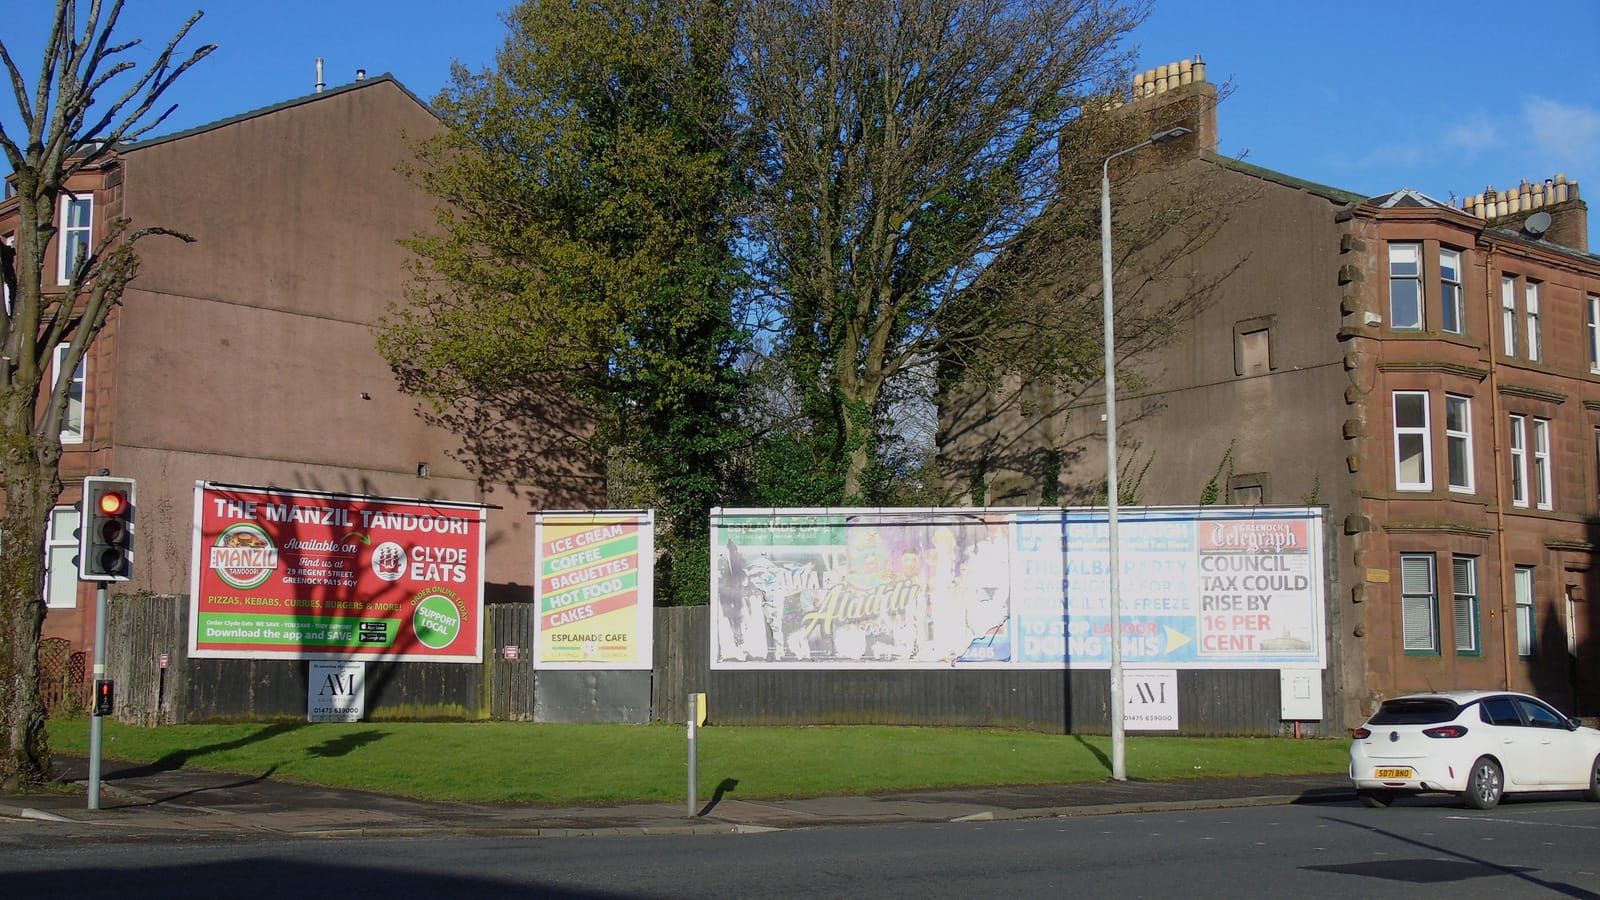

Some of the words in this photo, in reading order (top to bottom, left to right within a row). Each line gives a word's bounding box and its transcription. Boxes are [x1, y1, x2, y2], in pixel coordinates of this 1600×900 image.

[214, 498, 257, 520] THE
[266, 503, 353, 528] MANZIL
[360, 510, 469, 535] TANDOORI
[1239, 524, 1286, 532] GREENOCK
[550, 539, 573, 554] ICE
[576, 525, 624, 545] CREAM
[1210, 522, 1297, 553] Telegraph
[284, 538, 339, 553] Available
[342, 544, 358, 554] on
[216, 549, 276, 567] MANZIL
[411, 546, 467, 563] CLYDE
[550, 548, 602, 571] COFFEE
[299, 558, 320, 568] Find
[334, 560, 344, 568] at
[1124, 560, 1188, 576] PARTY
[1201, 556, 1290, 572] COUNCIL
[298, 569, 326, 577] REGENT
[411, 562, 466, 582] EATS
[551, 558, 629, 590] BAGUETTES
[283, 576, 322, 585] GREENOCK
[1201, 576, 1238, 591] TAX
[1243, 575, 1308, 591] COULD
[550, 592, 580, 609] HOT
[584, 578, 623, 600] FOOD
[208, 596, 241, 606] PIZZAS,
[245, 598, 281, 607] KEBABS,
[284, 599, 322, 609] CURRIES,
[325, 601, 363, 609] BURGERS
[411, 588, 431, 606] ORDER
[432, 586, 456, 598] ONLINE
[456, 598, 468, 622] TODAY
[1098, 598, 1128, 610] TX
[1134, 598, 1192, 610] FREEZE
[1202, 595, 1243, 611] RISE
[1248, 595, 1272, 611] BY
[419, 607, 457, 626] SUPPORT
[550, 605, 594, 627] CAKES
[1204, 615, 1227, 631] 16
[1232, 615, 1271, 631] PER
[206, 628, 262, 638] Download
[264, 629, 280, 639] the
[284, 631, 303, 641] app
[305, 630, 324, 640] and
[327, 632, 352, 640] SAVE
[421, 618, 448, 635] LOCAL
[1024, 622, 1046, 634] TO
[1049, 621, 1090, 634] STOP
[1094, 622, 1157, 635] LAOUR
[552, 634, 603, 642] ESPLANADE
[1204, 634, 1256, 651] CENT
[1024, 637, 1102, 656] DOING
